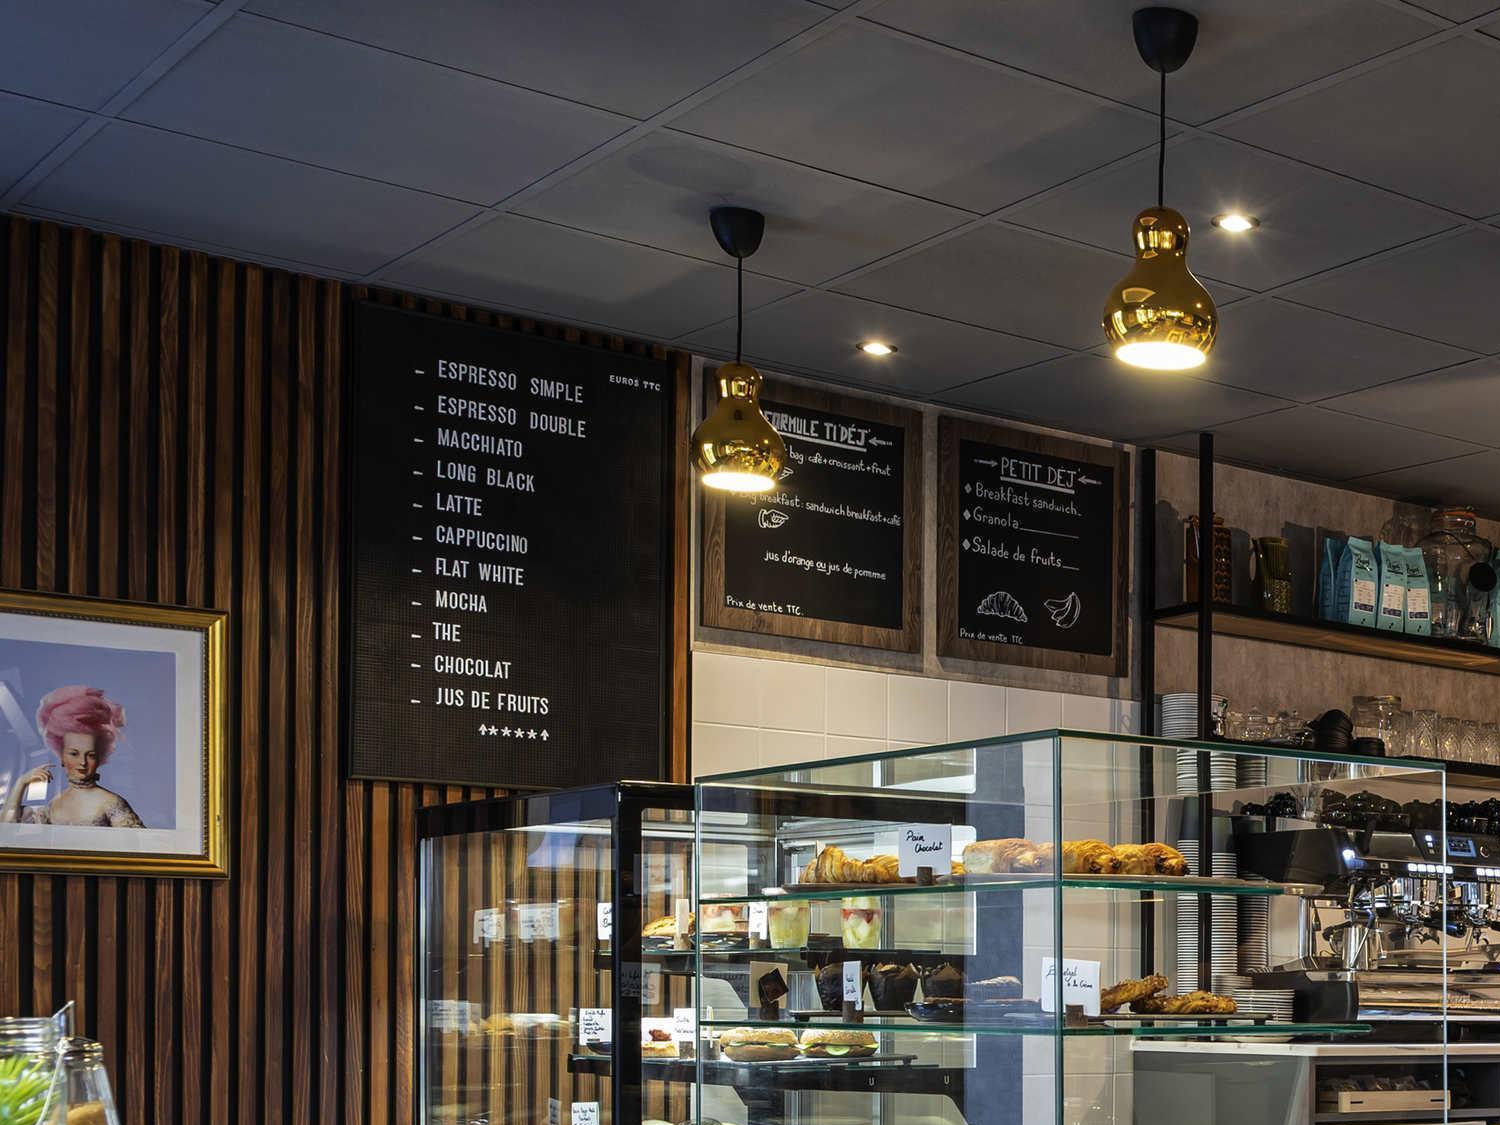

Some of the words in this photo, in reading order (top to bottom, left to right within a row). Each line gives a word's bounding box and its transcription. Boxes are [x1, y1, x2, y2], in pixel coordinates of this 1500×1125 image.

[438, 360, 517, 391] ESPRESSO
[530, 377, 584, 404] SIMPLE
[609, 374, 640, 387] EUROS
[437, 395, 518, 427] ESPRESSO
[529, 411, 587, 439] DOUBLE
[764, 410, 819, 438] FORMULE
[437, 427, 523, 459] MACCHIATO
[437, 460, 477, 484] LONG
[486, 468, 536, 494] BLACK
[1000, 456, 1043, 482] PETIT
[436, 493, 483, 517] LATTE
[805, 501, 845, 516] sandwich
[975, 482, 1030, 507] Breakfast
[1032, 497, 1077, 517] sandwich
[973, 506, 1019, 530] Granola
[436, 525, 529, 555] CAPPUCCINO
[972, 535, 1009, 559] Salade
[1012, 544, 1026, 563] de
[1030, 547, 1062, 568] fruits
[435, 557, 470, 580] FLAT
[478, 563, 525, 587] WHITE
[763, 550, 780, 562] jus
[781, 550, 815, 571] d'orange
[816, 559, 827, 571] ou
[826, 562, 841, 576] jus
[842, 562, 853, 575] de
[435, 590, 488, 614] MOCHA
[726, 594, 744, 608] Prix
[745, 599, 757, 611] de
[757, 601, 784, 614] vente
[432, 621, 461, 644] THE
[960, 627, 975, 639] Prix
[976, 628, 987, 641] de
[988, 632, 1008, 643] vente
[433, 654, 512, 681] CHOCOLAT
[435, 687, 464, 709] JUS
[471, 689, 491, 711] DE
[497, 693, 550, 715] FRUITS
